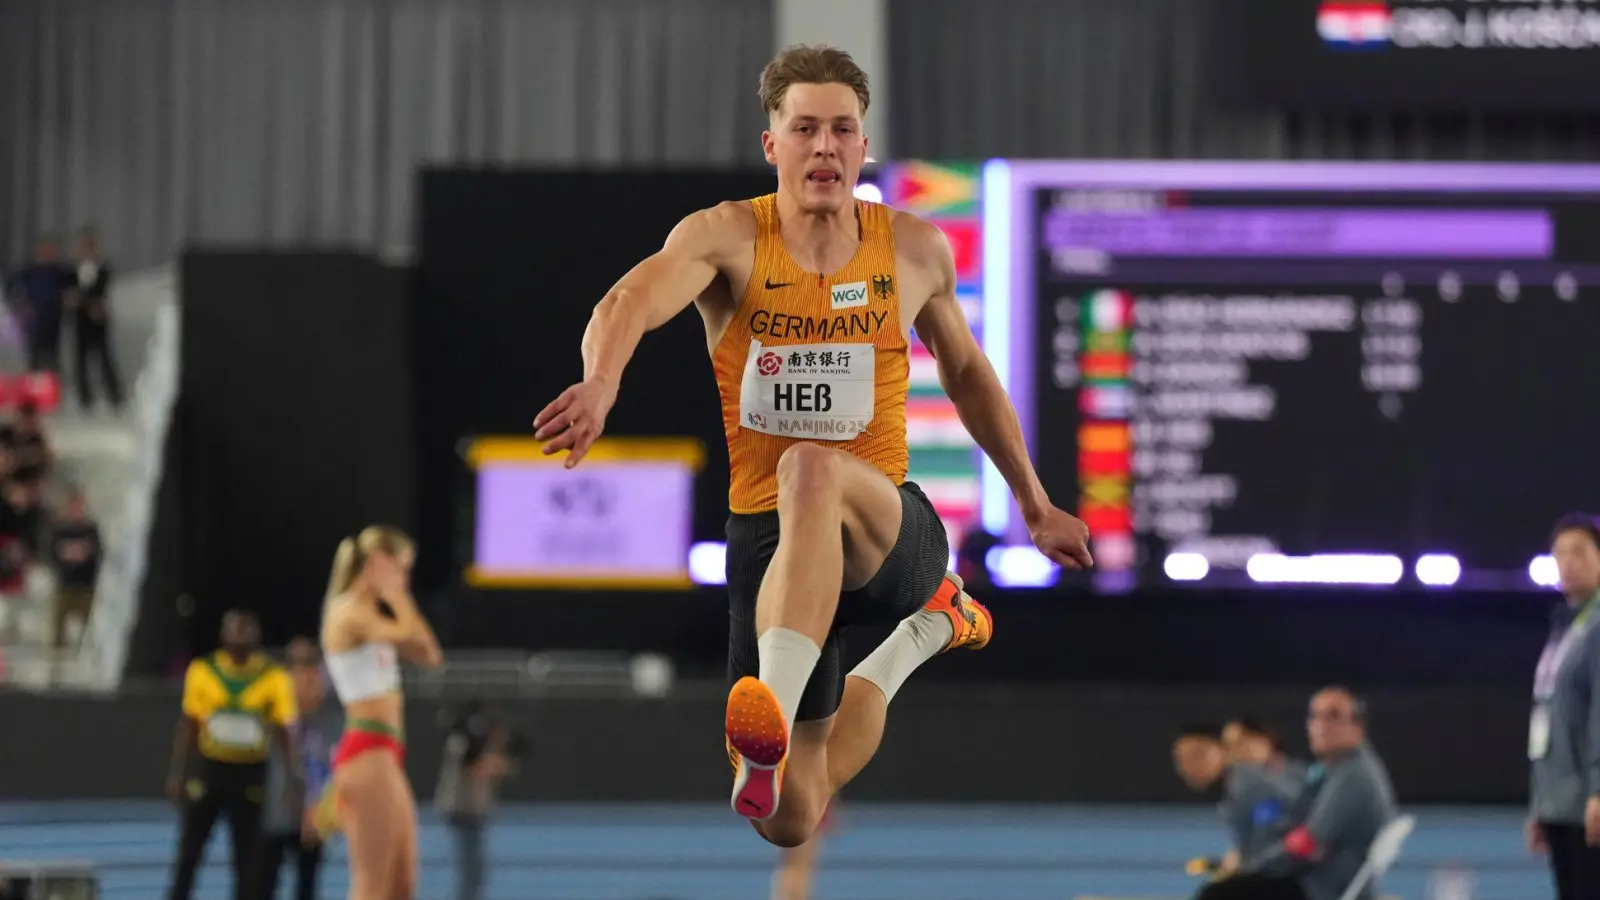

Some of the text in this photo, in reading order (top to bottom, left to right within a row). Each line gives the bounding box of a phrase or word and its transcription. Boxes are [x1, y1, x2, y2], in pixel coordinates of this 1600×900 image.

[832, 287, 866, 304] WGV
[750, 310, 888, 341] GERMANY
[788, 351, 851, 368] 南京银行
[777, 418, 846, 434] NANJING
